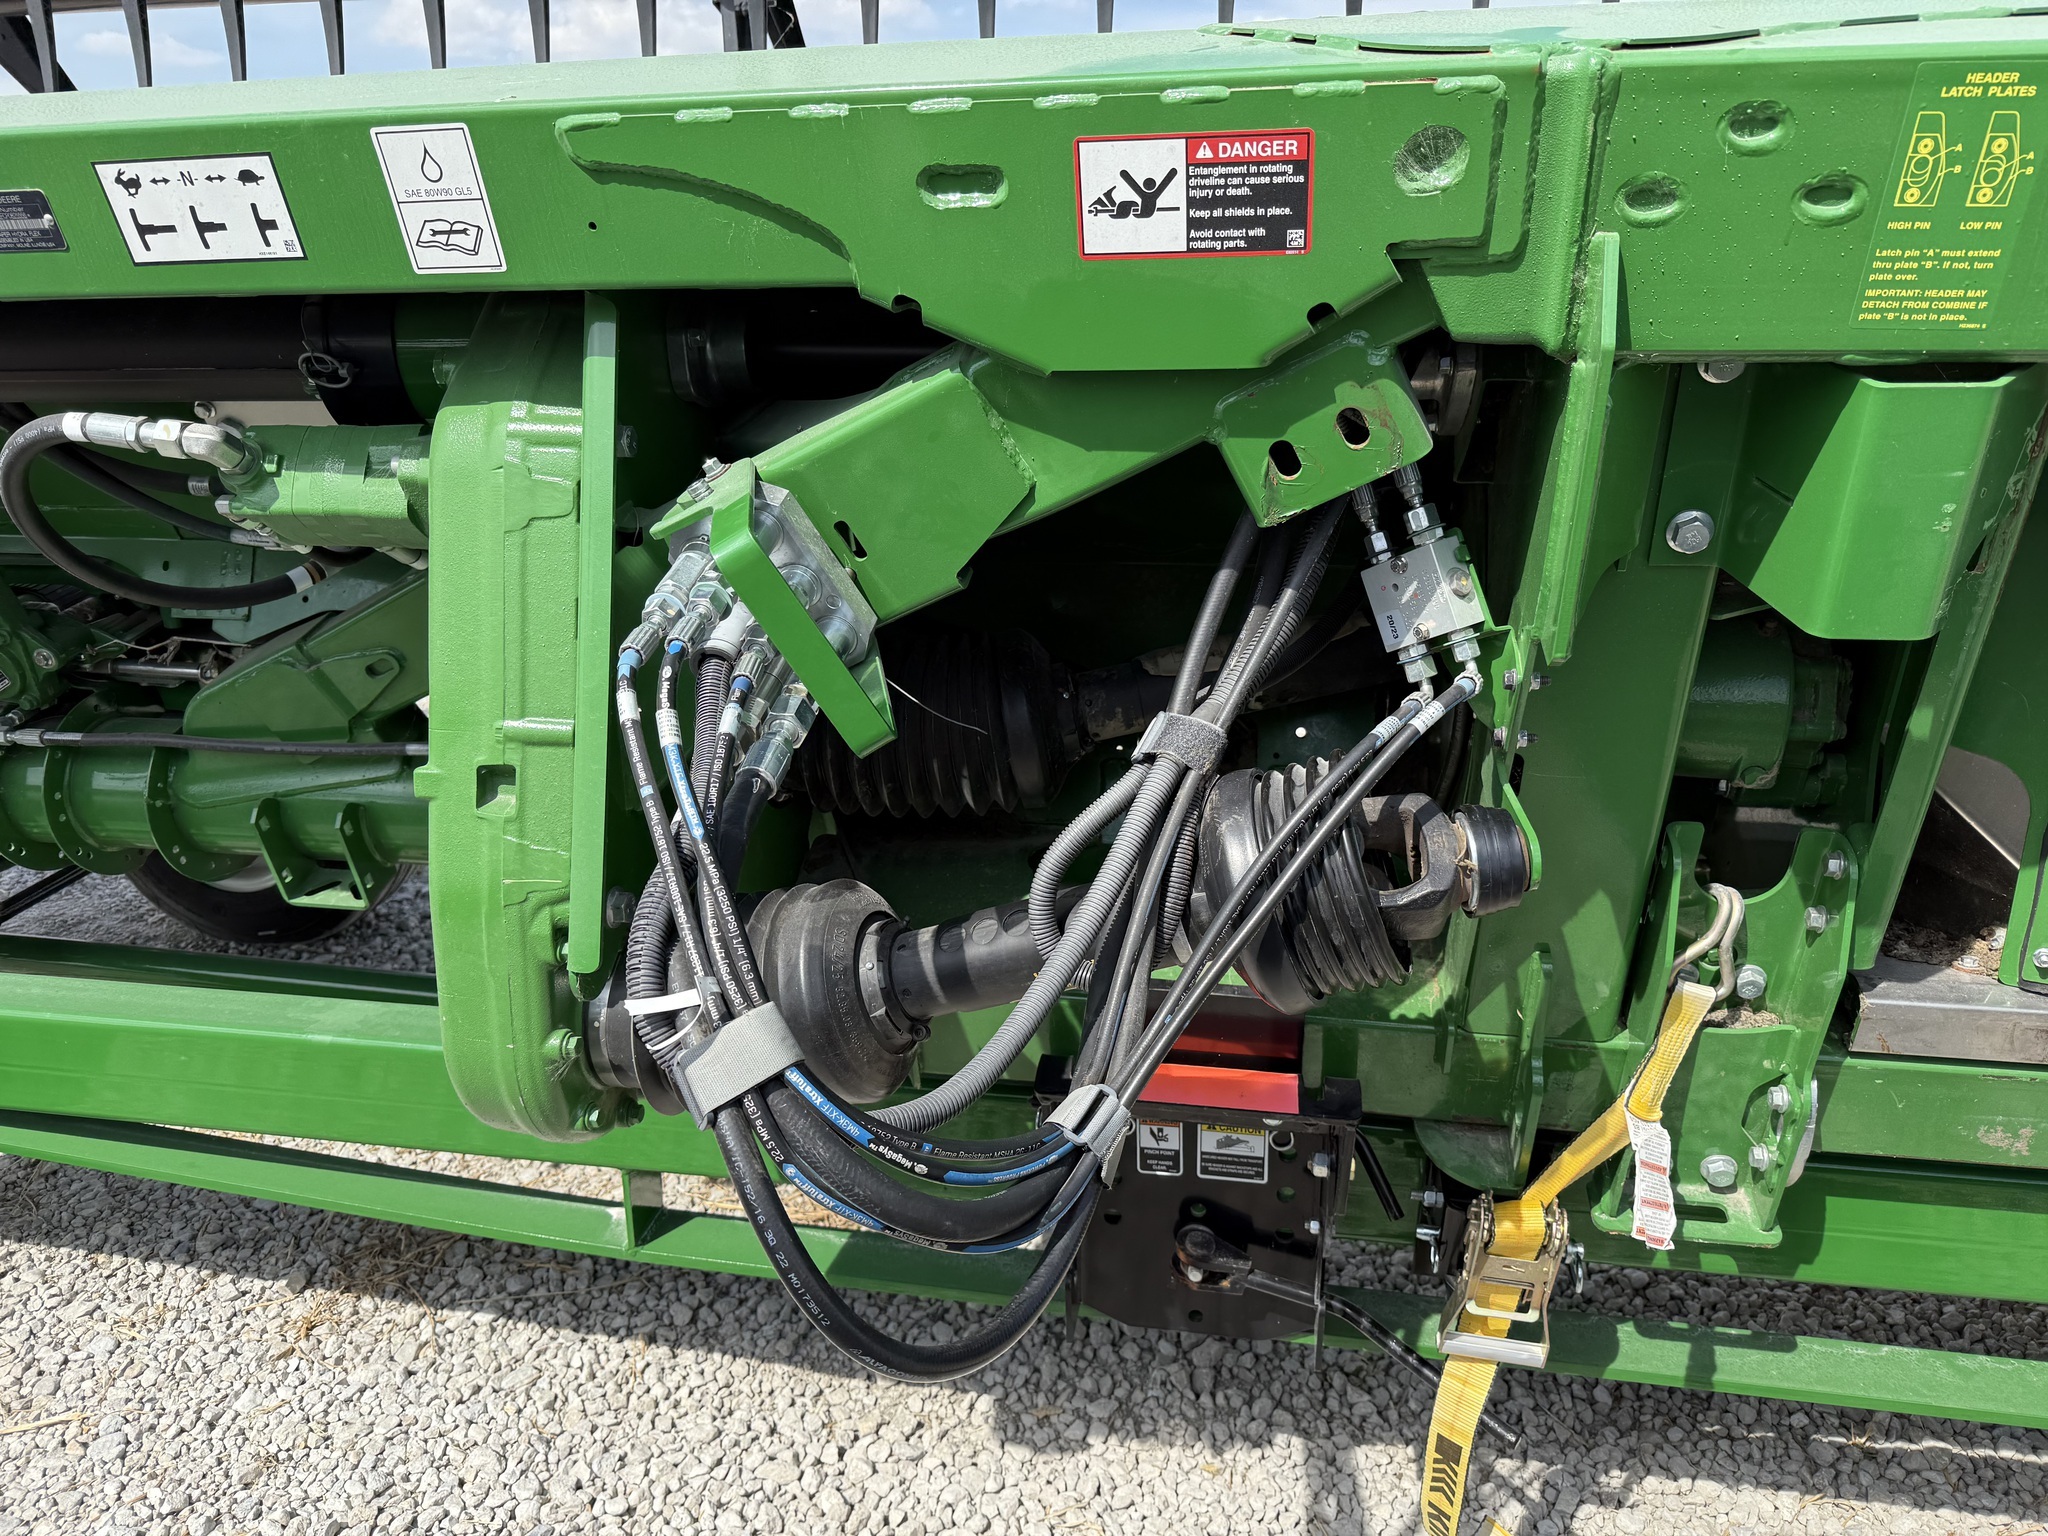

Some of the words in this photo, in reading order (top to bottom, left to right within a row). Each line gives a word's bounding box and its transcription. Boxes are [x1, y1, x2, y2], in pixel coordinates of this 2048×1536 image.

[1966, 73, 2020, 83] HEADER
[1941, 87, 1983, 97] LATCH
[1987, 86, 2037, 96] PLATES
[1218, 140, 1298, 158] DANGER
[1955, 143, 1962, 151] A
[1189, 164, 1247, 176] Entanglement
[1249, 165, 1258, 174] in
[1260, 164, 1293, 175] rotating
[1953, 165, 1962, 173] B
[2026, 167, 2034, 175] B
[1189, 177, 1225, 186] driveline
[1227, 177, 1242, 185] can
[1244, 177, 1270, 185] cause
[1272, 174, 1304, 184] serious
[0, 195, 22, 204] EERE
[404, 189, 423, 198] SAE
[424, 188, 453, 198] 80W90
[455, 187, 472, 196] GL5
[1189, 187, 1213, 198] injury
[1227, 187, 1252, 196] death.
[1189, 208, 1210, 220] Keep
[1212, 208, 1223, 217] all
[1225, 208, 1255, 217] shields
[1257, 207, 1265, 215] in
[1267, 206, 1293, 217] place.
[1189, 229, 1213, 238] Avoid
[1215, 229, 1246, 238] contact
[1247, 228, 1266, 237] with
[1189, 240, 1221, 250] rotating
[1223, 239, 1247, 249] parts.
[1876, 249, 1902, 257] Latch
[1904, 249, 1920, 258] pin
[1941, 249, 1966, 257] must
[1968, 249, 2001, 257] extend
[1894, 261, 1918, 270] plate
[1952, 261, 1971, 270] not,
[1869, 273, 1893, 282] plate
[1865, 289, 1922, 297] IMPORTANT:
[1862, 301, 1899, 309] DETACH
[1902, 301, 1930, 309] FROM
[1932, 301, 1976, 309] COMBINE
[1858, 313, 1881, 321] plate
[1939, 313, 1967, 321] place.
[1386, 614, 1399, 639] 20/23
[627, 728, 642, 763] Resistant
[712, 758, 723, 773] ISO
[635, 761, 648, 786] Flame
[707, 778, 721, 807] 100R17
[645, 800, 654, 808] B
[648, 806, 661, 826] Type
[705, 807, 716, 825] SAE
[653, 824, 666, 852] 18752
[660, 850, 671, 865] ISO
[666, 872, 681, 904] 100R17
[675, 902, 688, 924] SAE
[700, 843, 713, 864] 22.5
[707, 864, 720, 886] MPa
[715, 885, 732, 915] (3250
[728, 915, 741, 937] PSI)
[739, 960, 754, 982] (6.3
[682, 929, 695, 948] R17
[719, 960, 733, 981] PSI)
[726, 981, 748, 1013] (3250
[821, 1103, 860, 1137] 4M3K-XTF
[743, 1094, 760, 1119] (325
[755, 1118, 771, 1141] MPa
[766, 1141, 785, 1162] 22.5
[892, 1135, 911, 1149] Type
[911, 1141, 917, 1150] B
[933, 1147, 957, 1158] Flame
[958, 1150, 993, 1160] Resistant
[775, 1251, 789, 1268] 22
